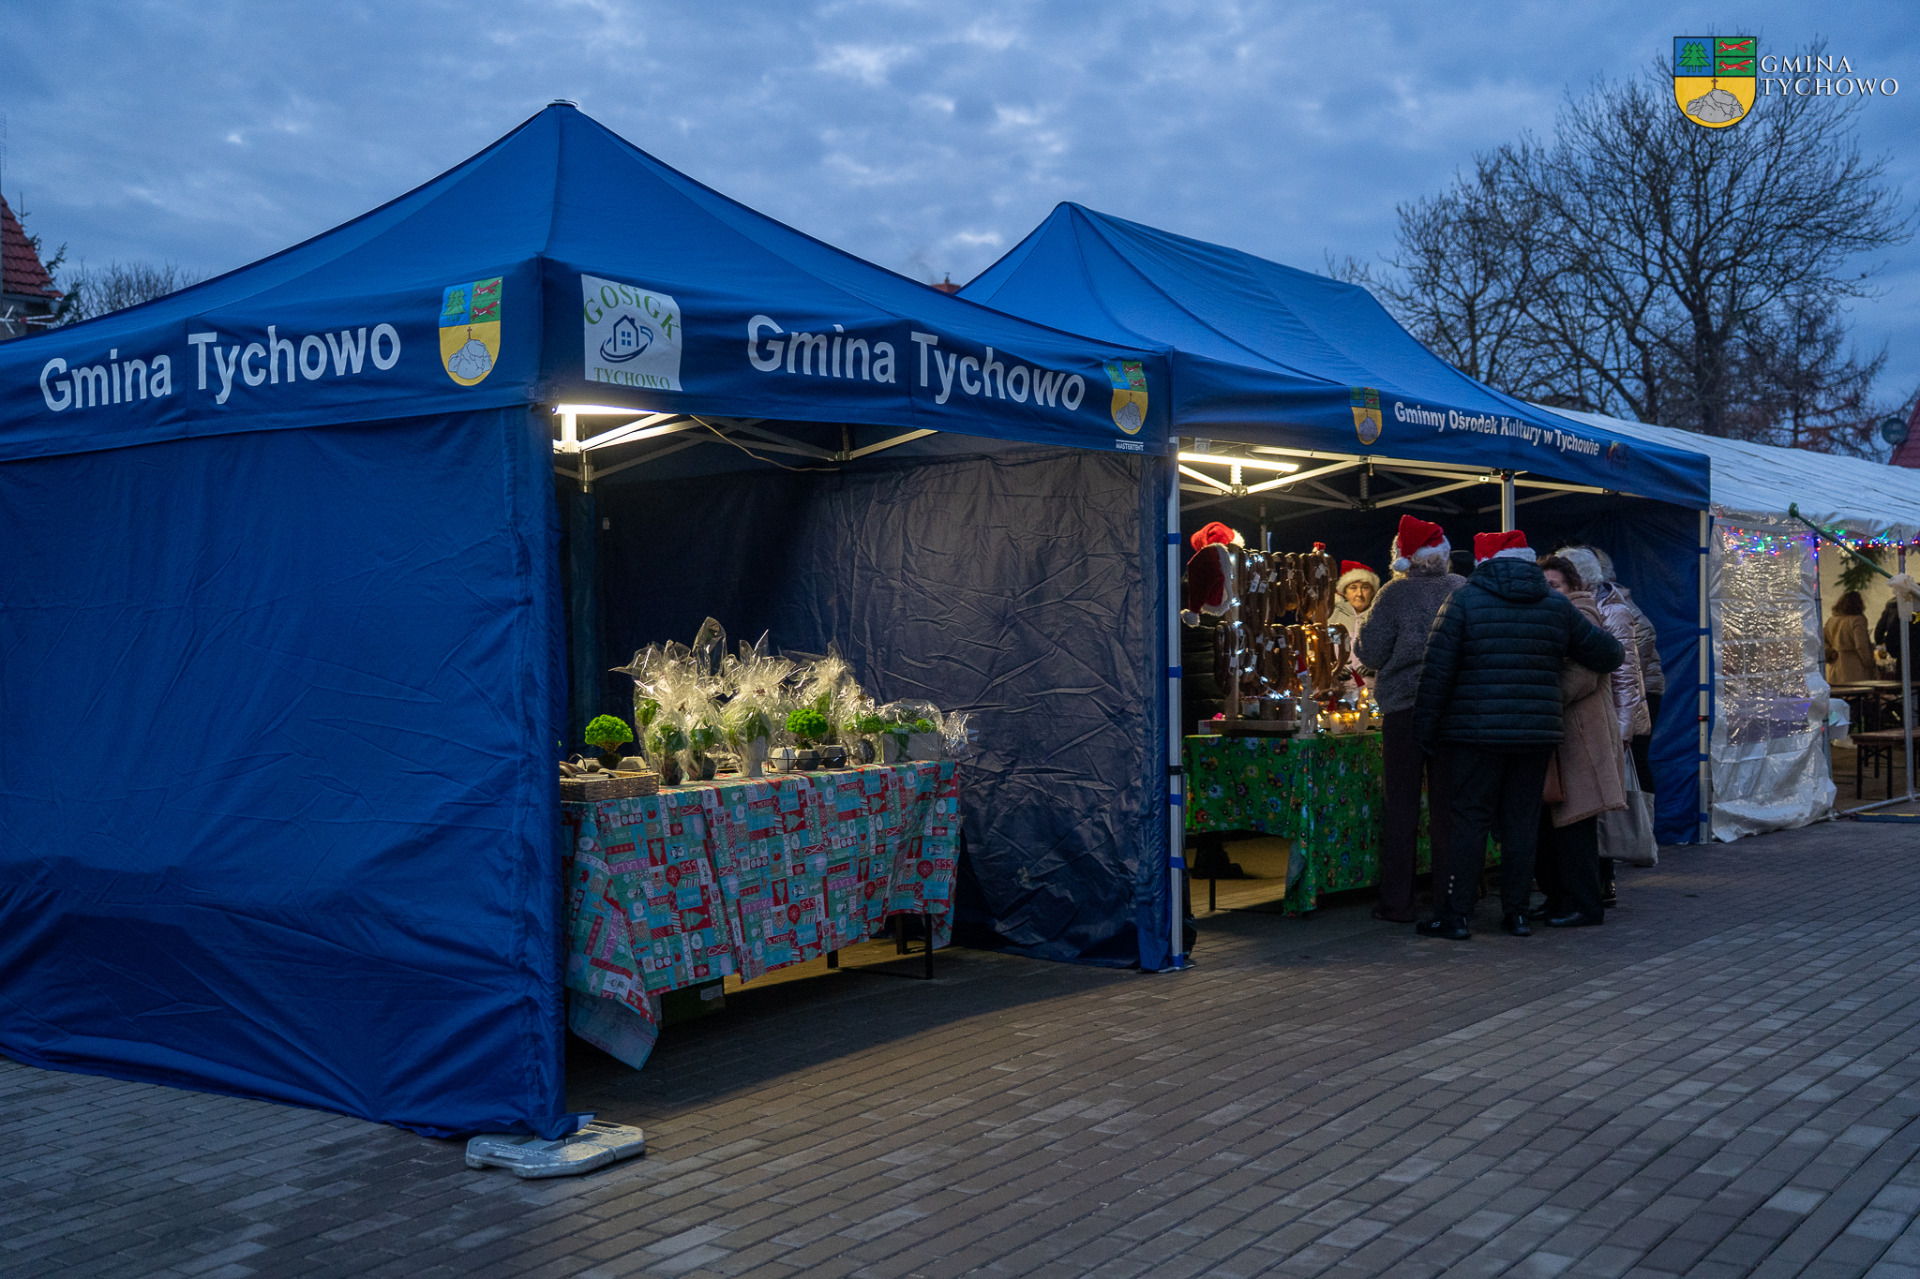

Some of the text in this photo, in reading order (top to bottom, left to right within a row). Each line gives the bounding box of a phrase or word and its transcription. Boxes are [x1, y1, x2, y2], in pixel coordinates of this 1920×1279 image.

[39, 323, 401, 412] Gmina Tychowo
[593, 367, 671, 390] TYCHOWO
[747, 314, 1086, 411] Gmina Tychowo
[1394, 402, 1600, 456] Gminny Ośrodek Kultury w Tychowie
